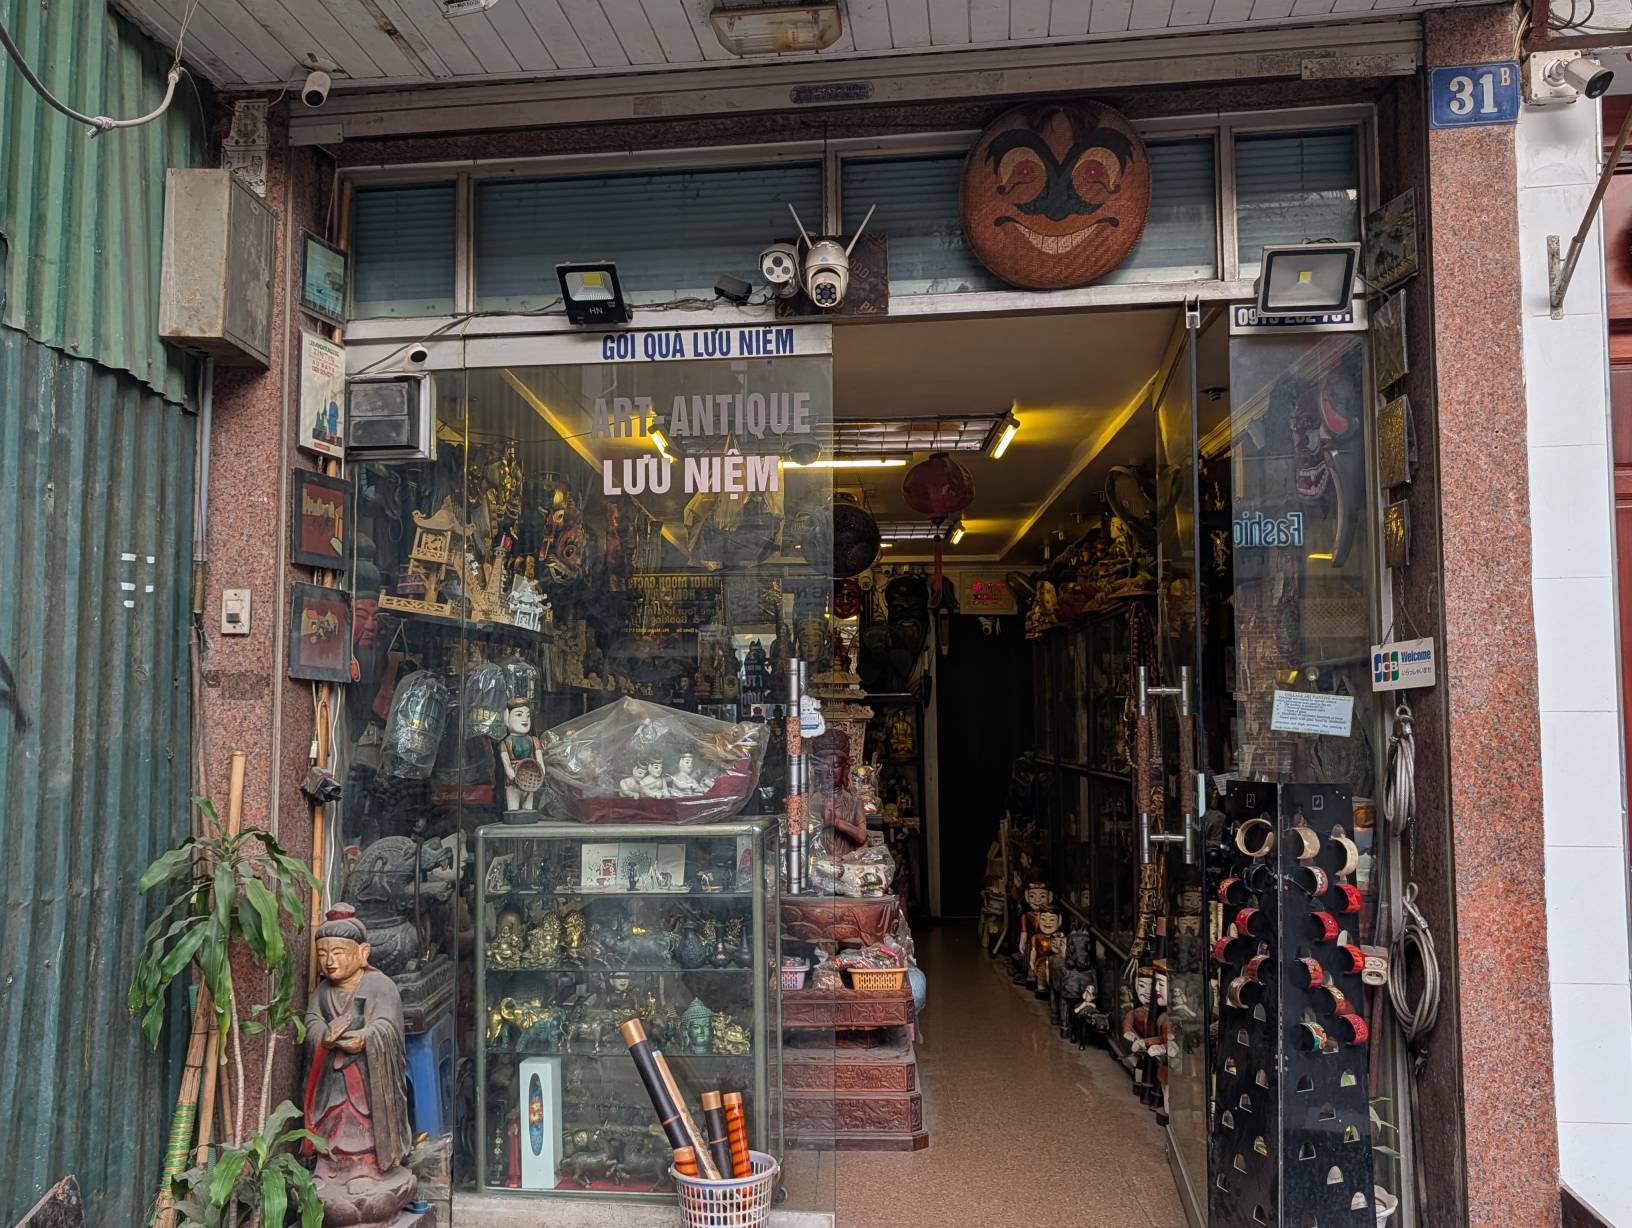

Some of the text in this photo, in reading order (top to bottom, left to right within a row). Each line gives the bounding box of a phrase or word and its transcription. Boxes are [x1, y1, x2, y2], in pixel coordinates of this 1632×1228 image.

[589, 306, 603, 315] HN
[603, 448, 779, 500] LƯU NIỆM
[1400, 649, 1432, 663] Welcome
[1375, 661, 1399, 673] JCB
